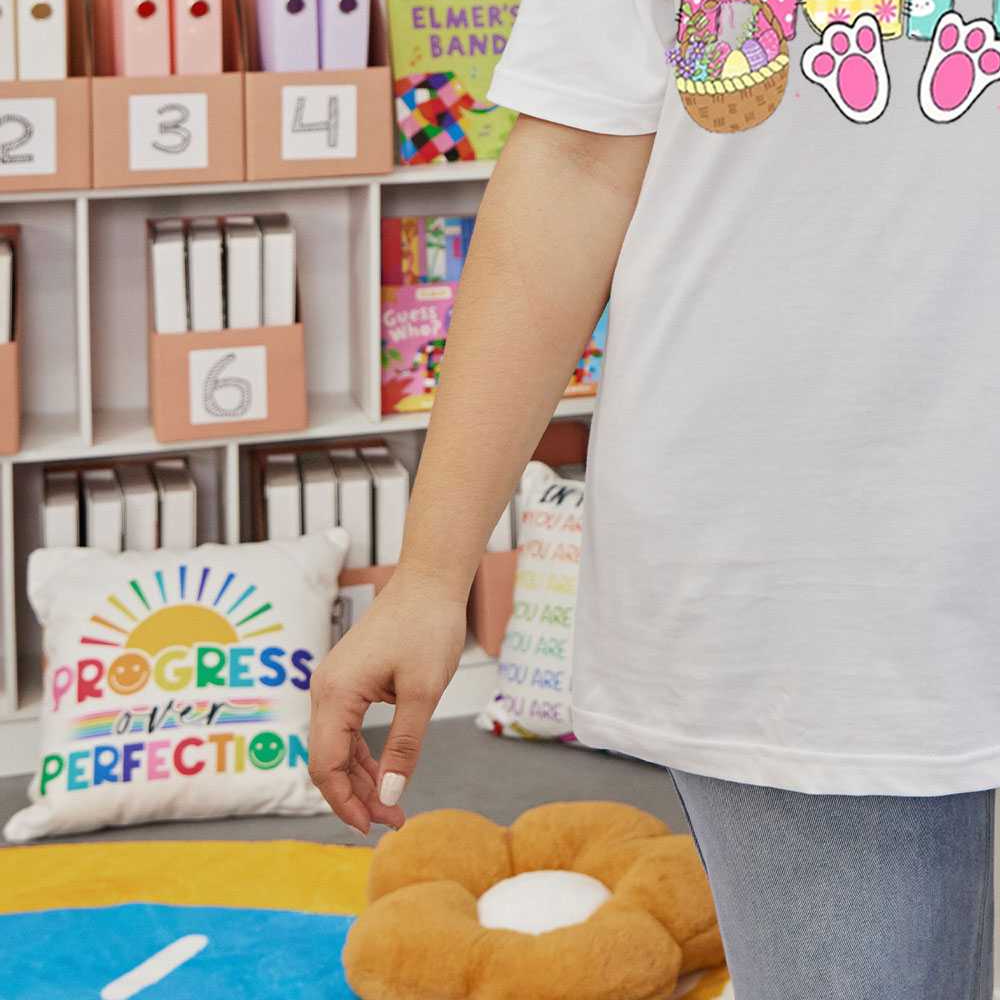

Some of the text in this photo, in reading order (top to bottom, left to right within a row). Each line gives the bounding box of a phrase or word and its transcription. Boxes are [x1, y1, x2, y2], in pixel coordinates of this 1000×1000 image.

[412, 4, 521, 30] ELMER'S
[429, 33, 509, 59] BAND
[152, 102, 192, 156] 3
[290, 95, 340, 149] 4
[383, 305, 438, 328] Guess
[203, 352, 252, 418] 6
[52, 645, 314, 712] PROGRESS
[115, 699, 233, 736] over
